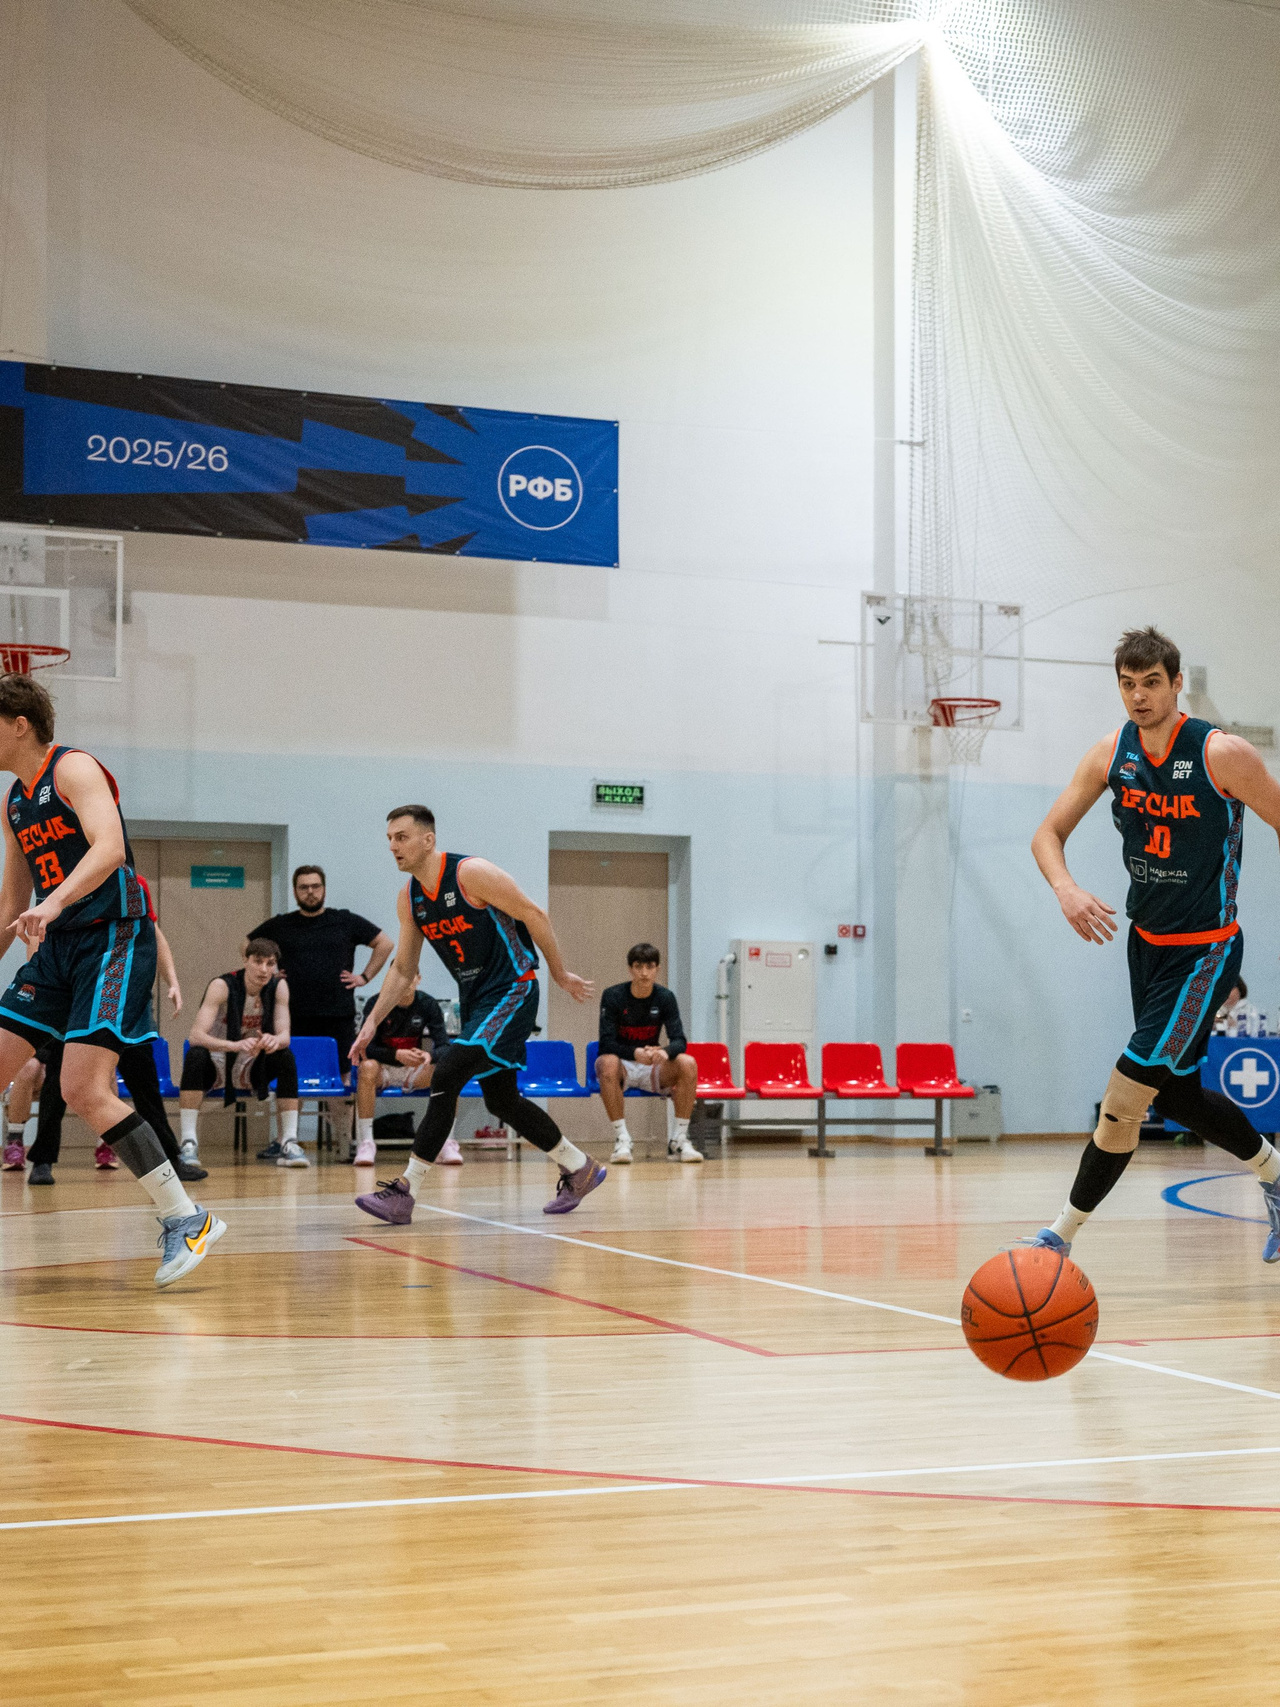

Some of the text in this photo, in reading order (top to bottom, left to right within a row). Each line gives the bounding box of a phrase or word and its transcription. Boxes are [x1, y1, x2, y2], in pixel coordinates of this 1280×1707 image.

[86, 434, 229, 472] 2025/26
[509, 474, 573, 502] РФБ
[1172, 770, 1193, 779] BET
[1173, 760, 1193, 770] FON
[599, 786, 641, 797] ВЫХОД
[35, 850, 65, 890] 33
[449, 940, 465, 963] 3
